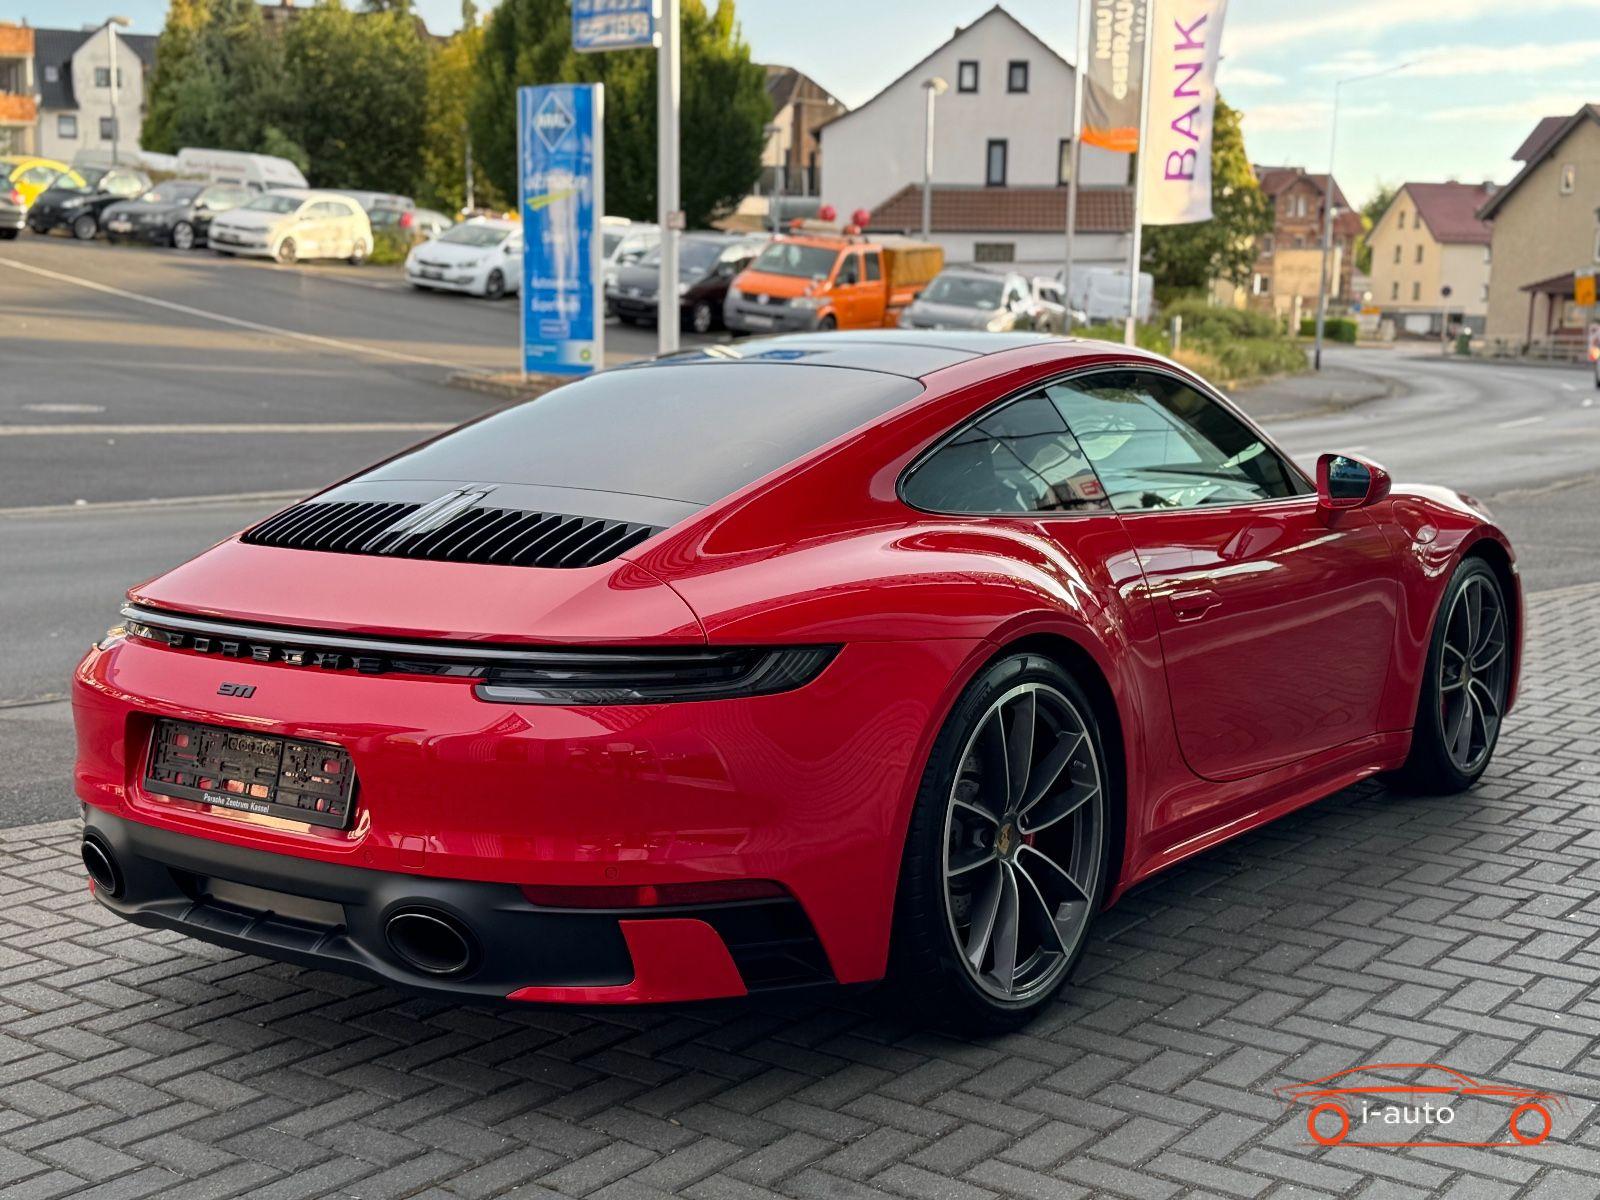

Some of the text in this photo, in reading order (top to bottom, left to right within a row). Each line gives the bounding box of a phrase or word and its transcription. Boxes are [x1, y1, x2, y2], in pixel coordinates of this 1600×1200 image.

[1111, 0, 1134, 101] GEBRAU
[1164, 13, 1208, 181] BANK
[216, 681, 258, 699] 911
[203, 792, 271, 813] Porsche Zentrum Kassel
